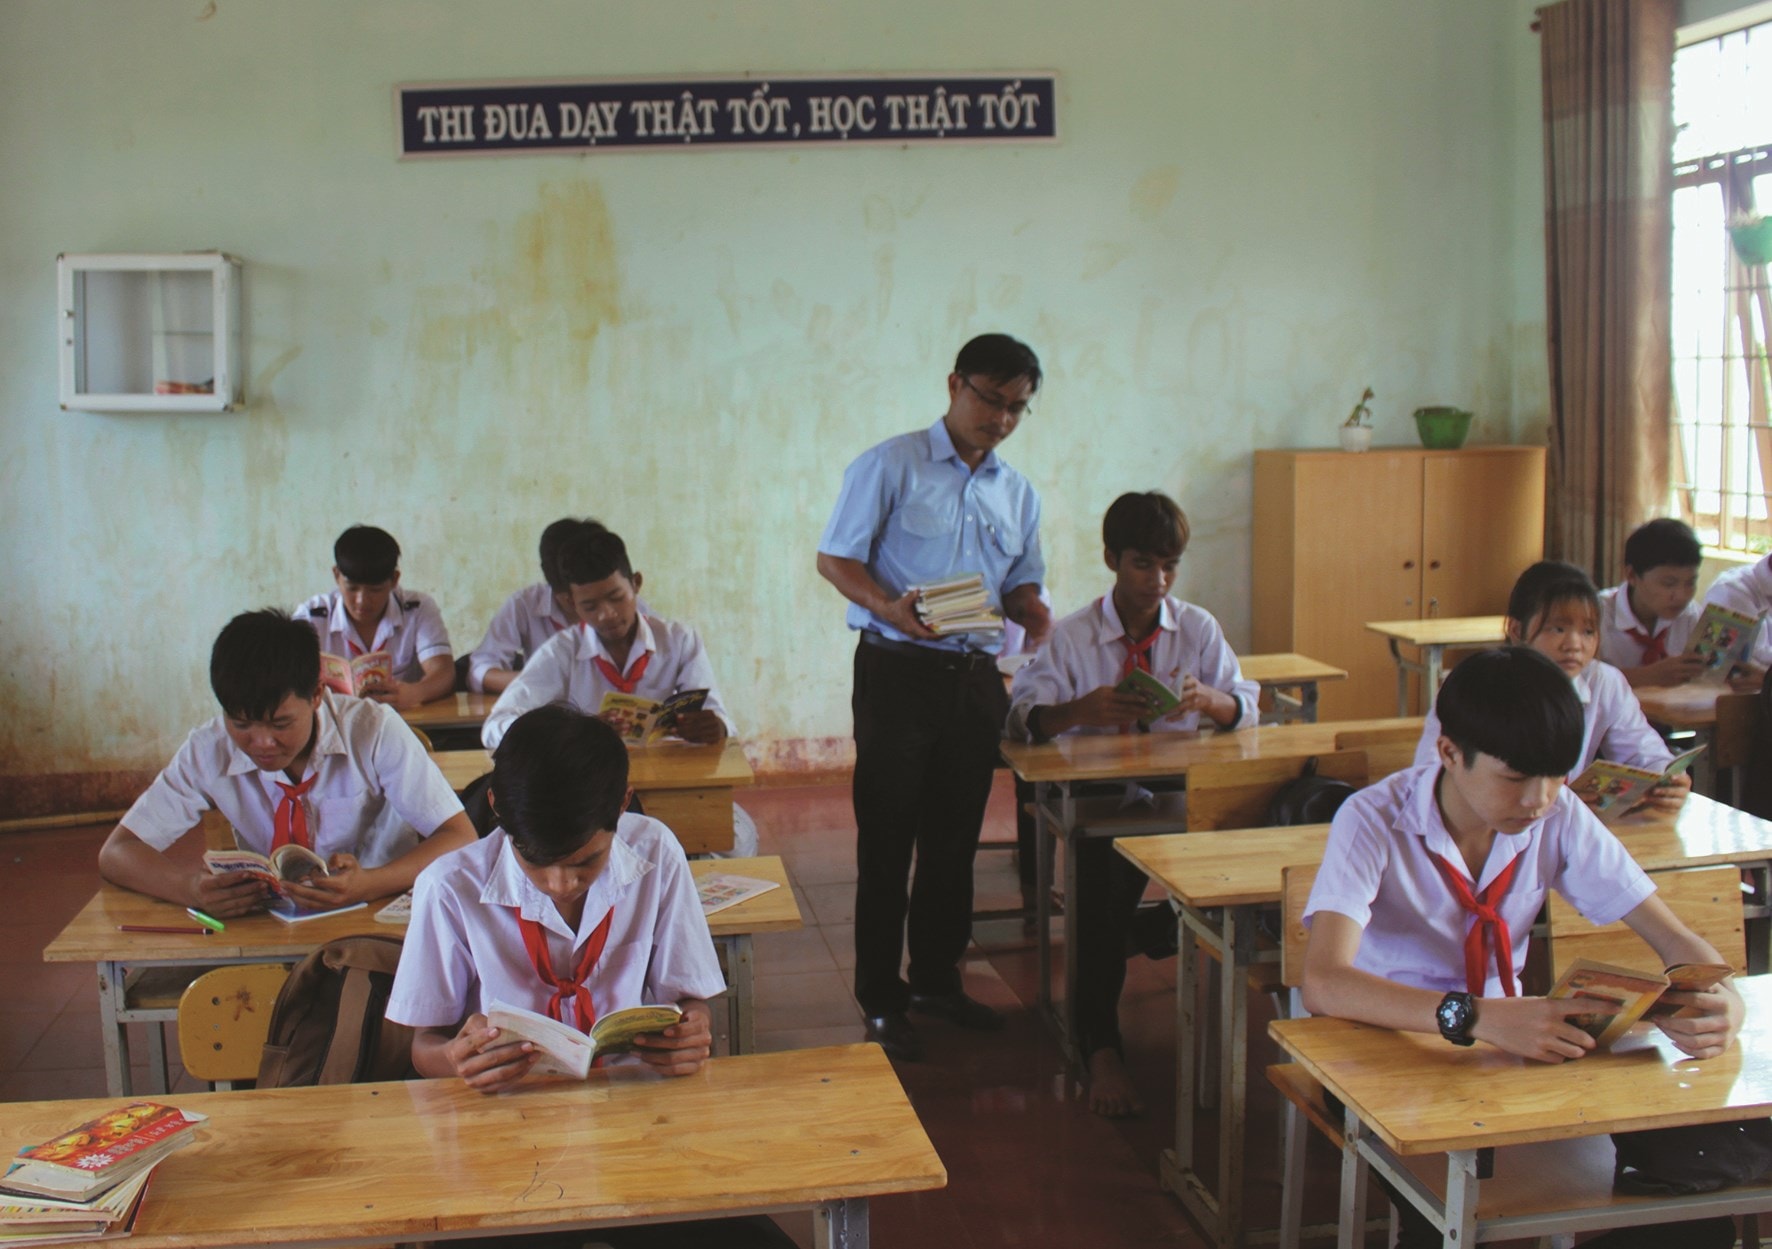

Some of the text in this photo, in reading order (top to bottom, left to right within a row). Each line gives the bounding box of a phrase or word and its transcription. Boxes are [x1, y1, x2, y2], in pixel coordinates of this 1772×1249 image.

[417, 79, 1041, 145] THI ĐUA DẠY THẬT TỐT, HỌC THẬT TỐT
